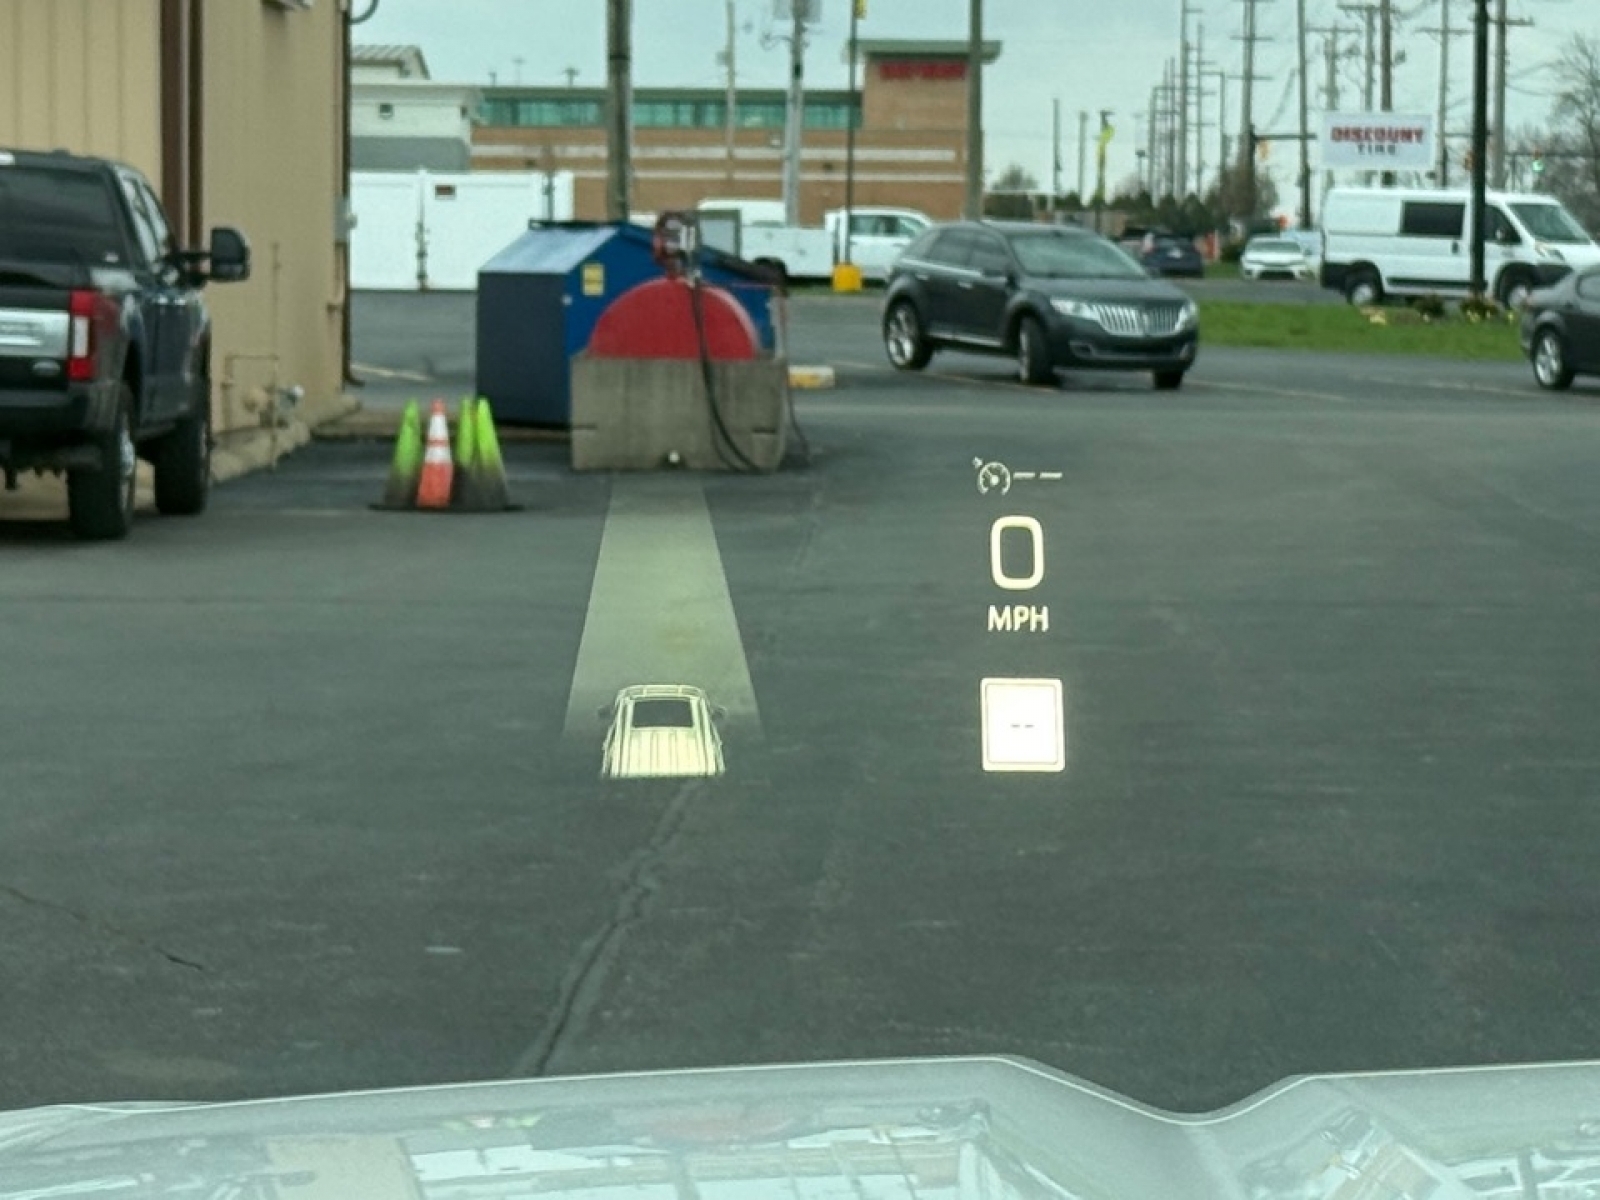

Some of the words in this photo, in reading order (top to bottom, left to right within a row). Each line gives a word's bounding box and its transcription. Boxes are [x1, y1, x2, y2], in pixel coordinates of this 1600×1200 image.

[1331, 127, 1424, 143] DISCOUNT
[990, 515, 1044, 591] 0
[987, 604, 1050, 632] MPH
